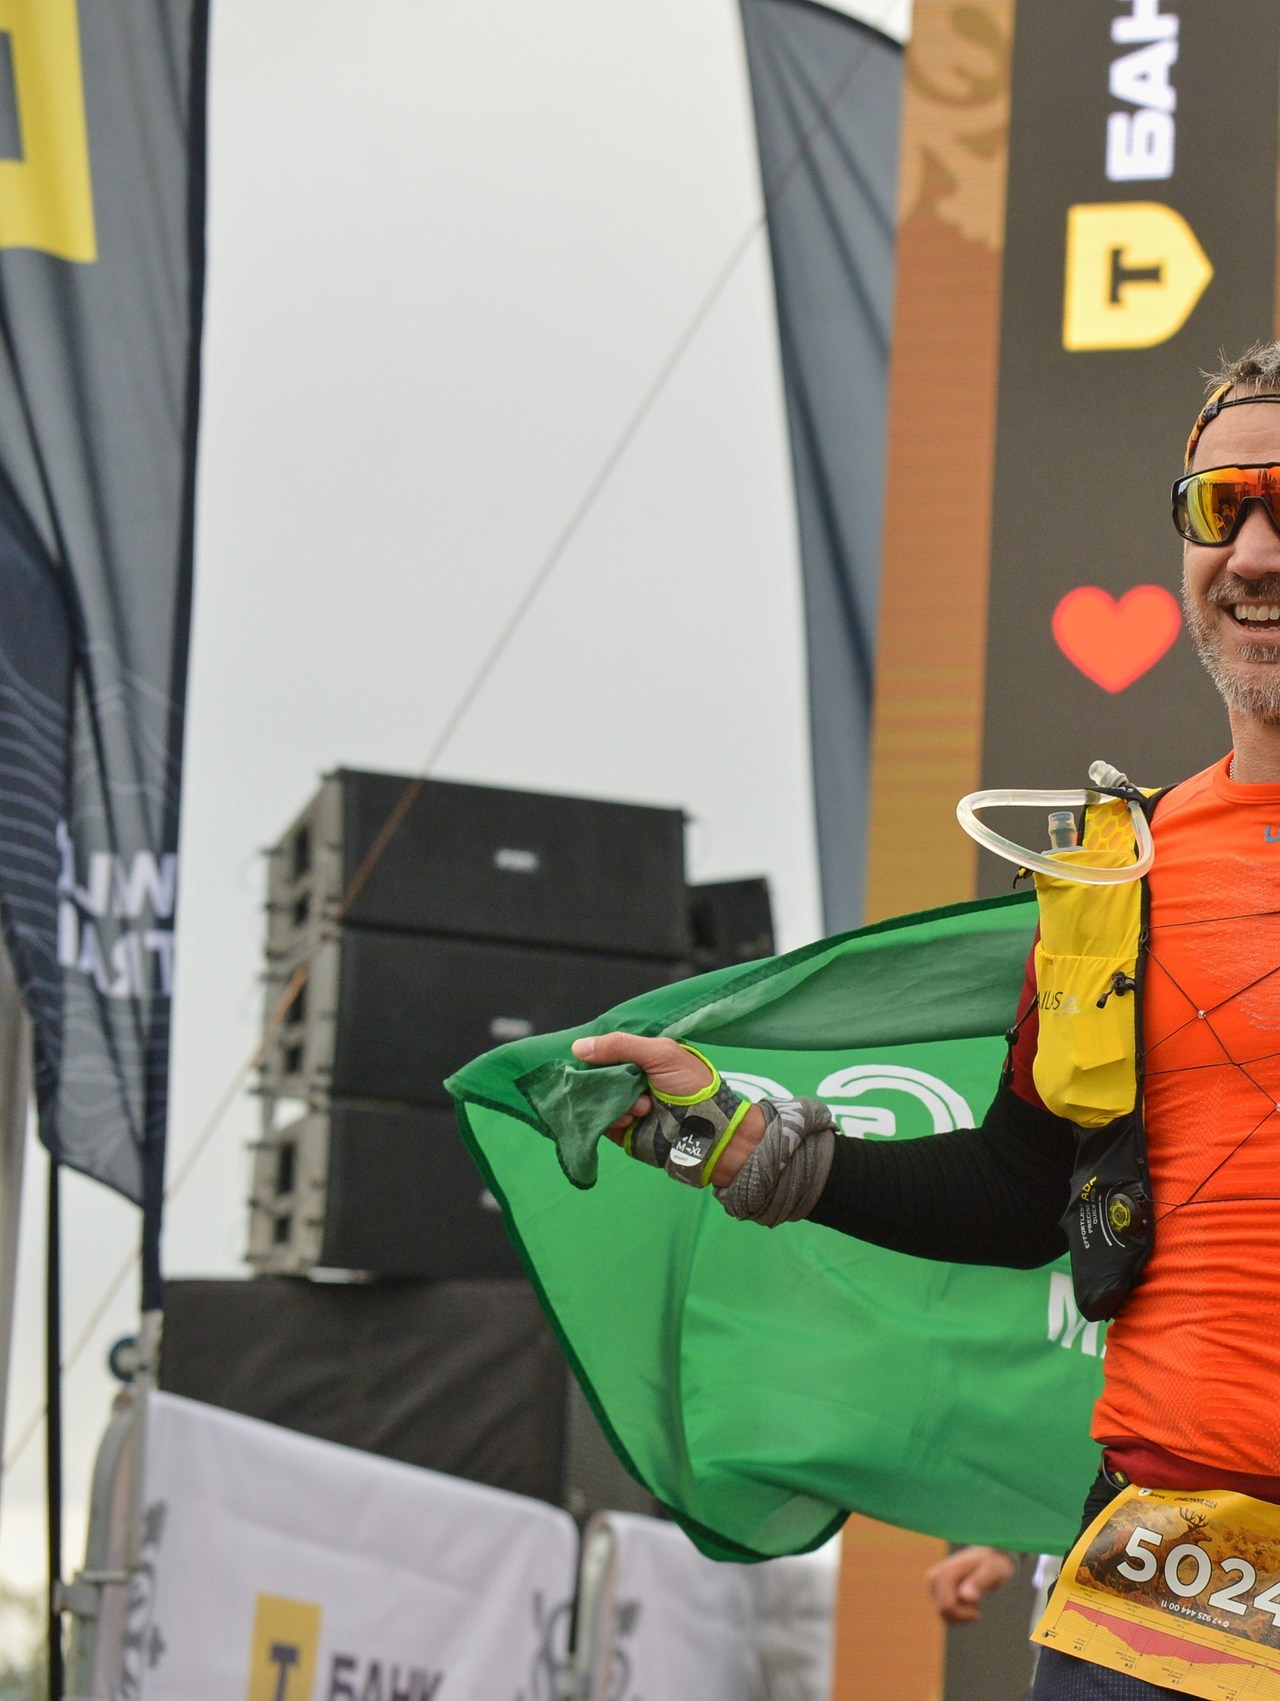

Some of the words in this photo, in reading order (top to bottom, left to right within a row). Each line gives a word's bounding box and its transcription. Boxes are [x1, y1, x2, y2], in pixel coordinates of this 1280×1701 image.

[1168, 1602, 1180, 1612] 00
[1181, 1606, 1196, 1617] 444
[1197, 1612, 1211, 1622] 925
